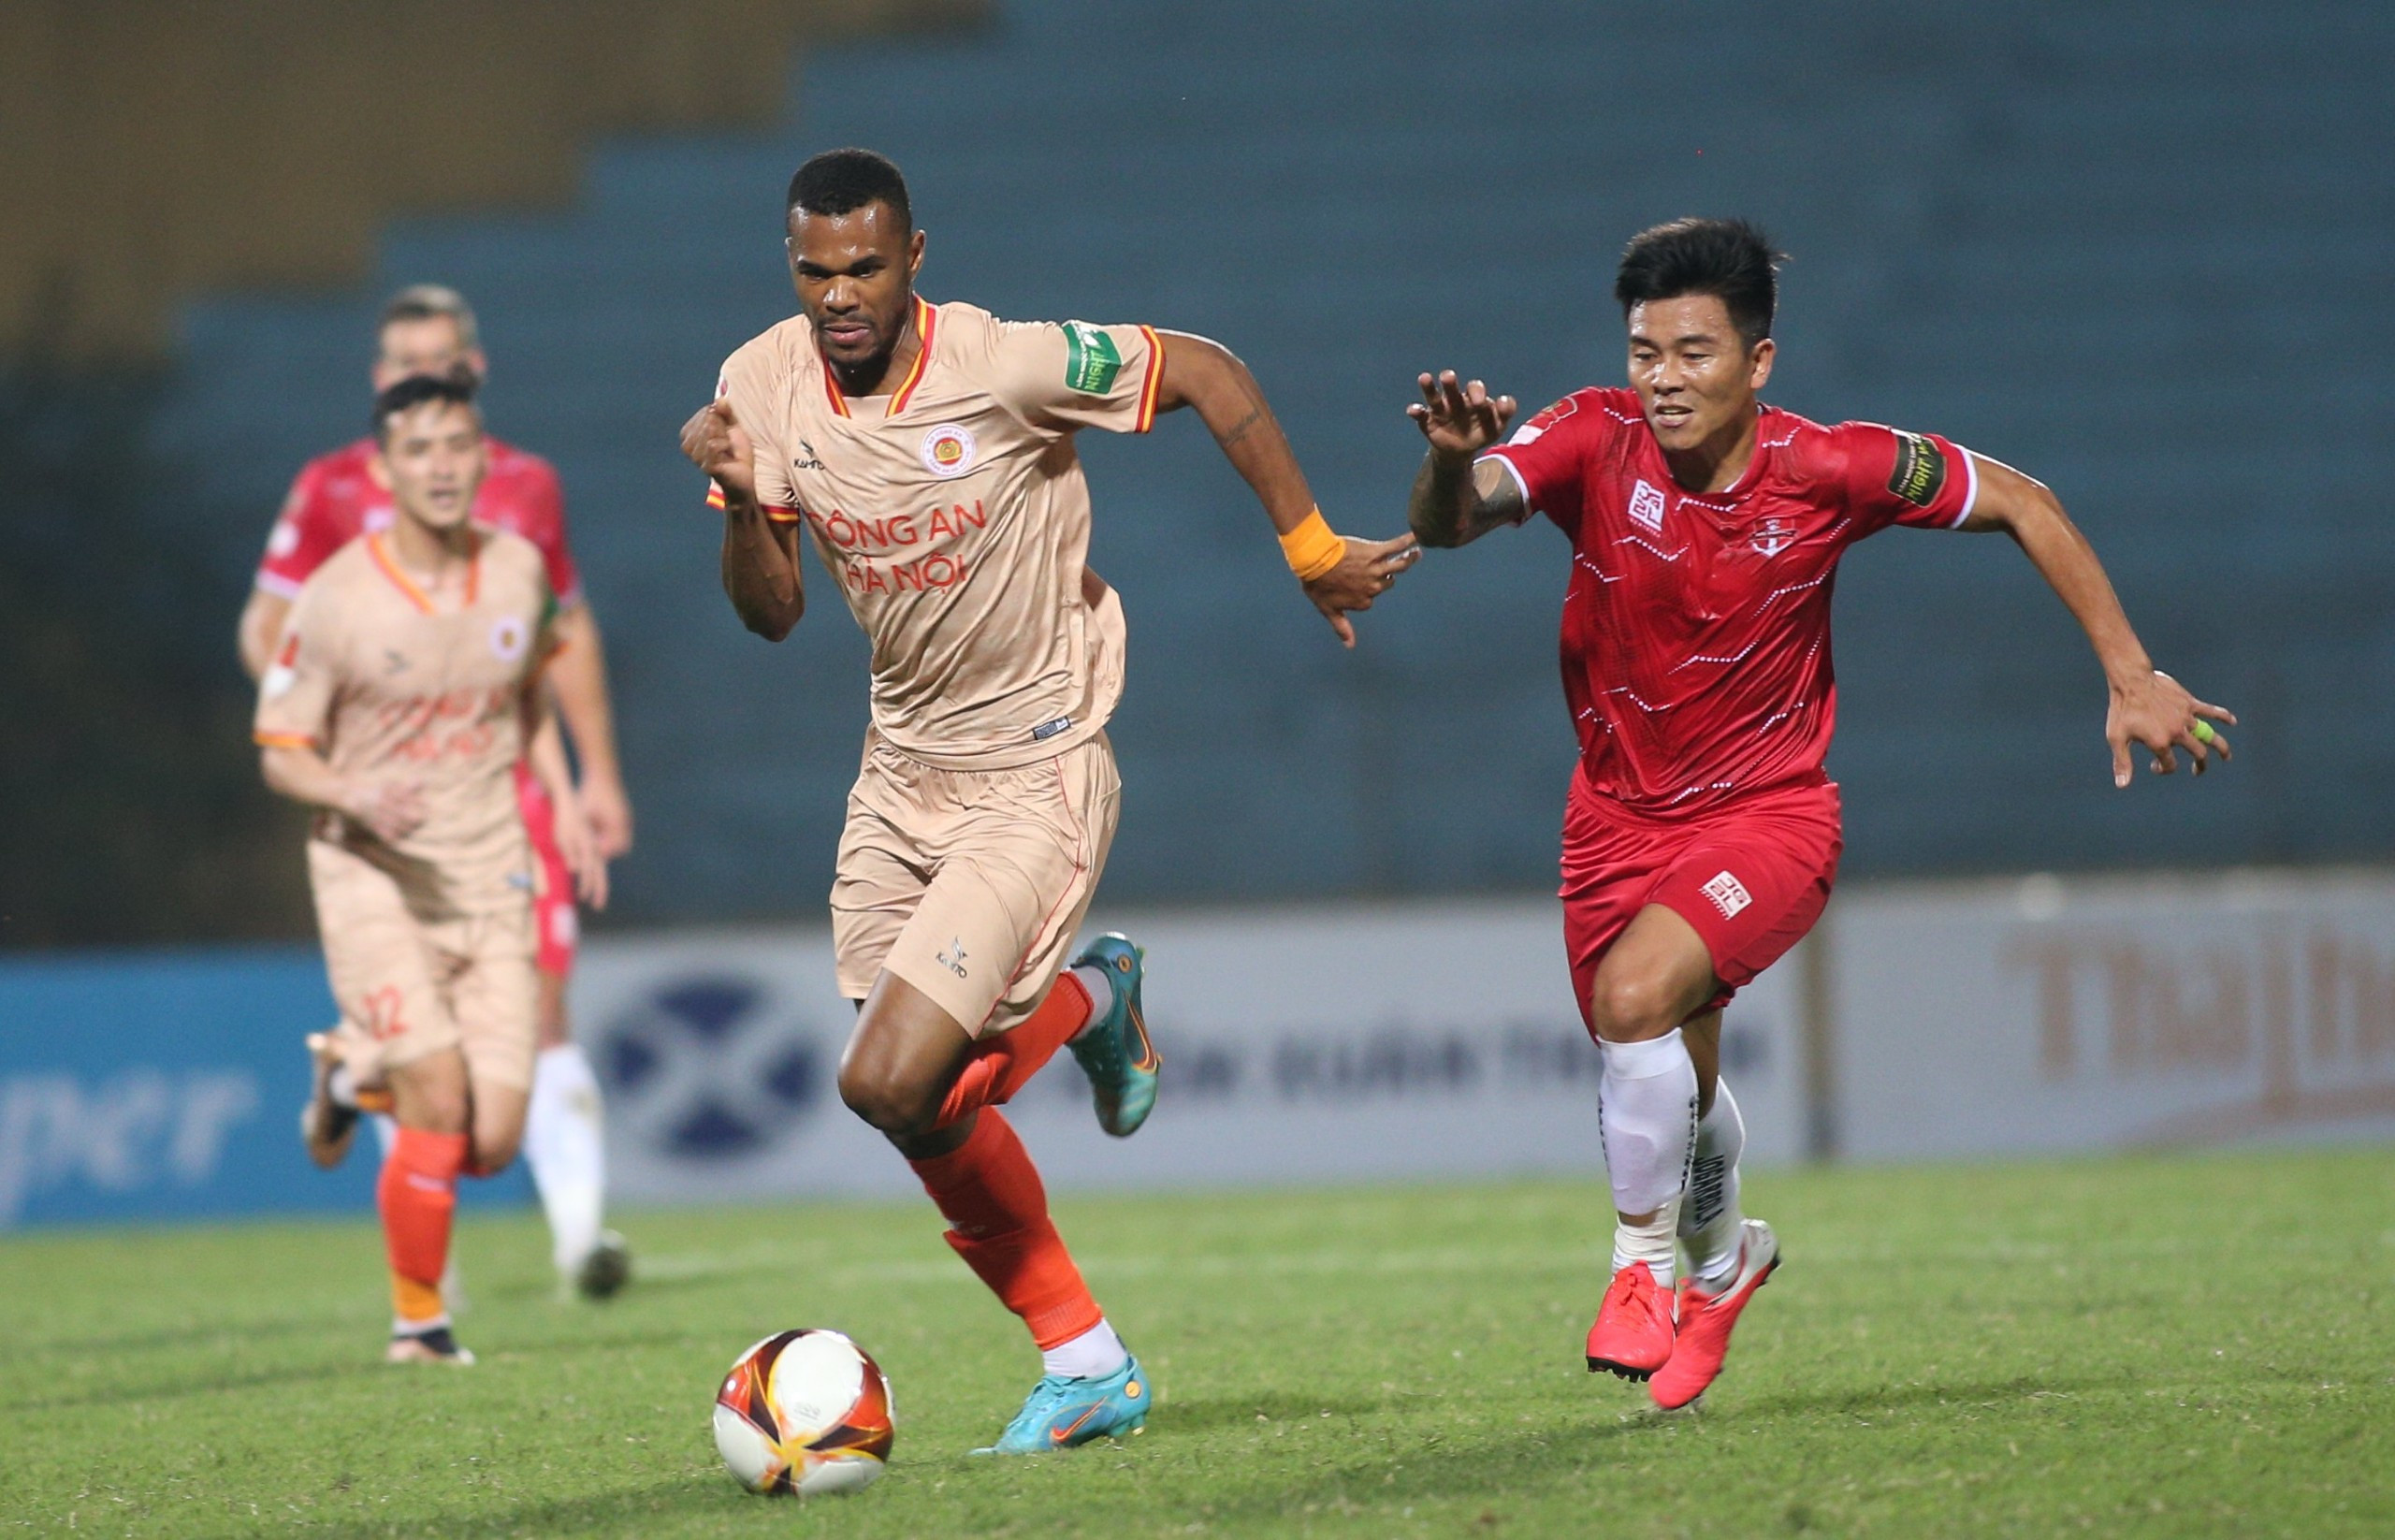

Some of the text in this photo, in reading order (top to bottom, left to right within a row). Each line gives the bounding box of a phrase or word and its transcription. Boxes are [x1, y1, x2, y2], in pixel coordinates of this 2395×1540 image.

[1084, 349, 1106, 390] NIGHT
[1907, 456, 1934, 501] NIGHT
[928, 499, 988, 542] AN
[846, 552, 967, 595] HÀ NỘI
